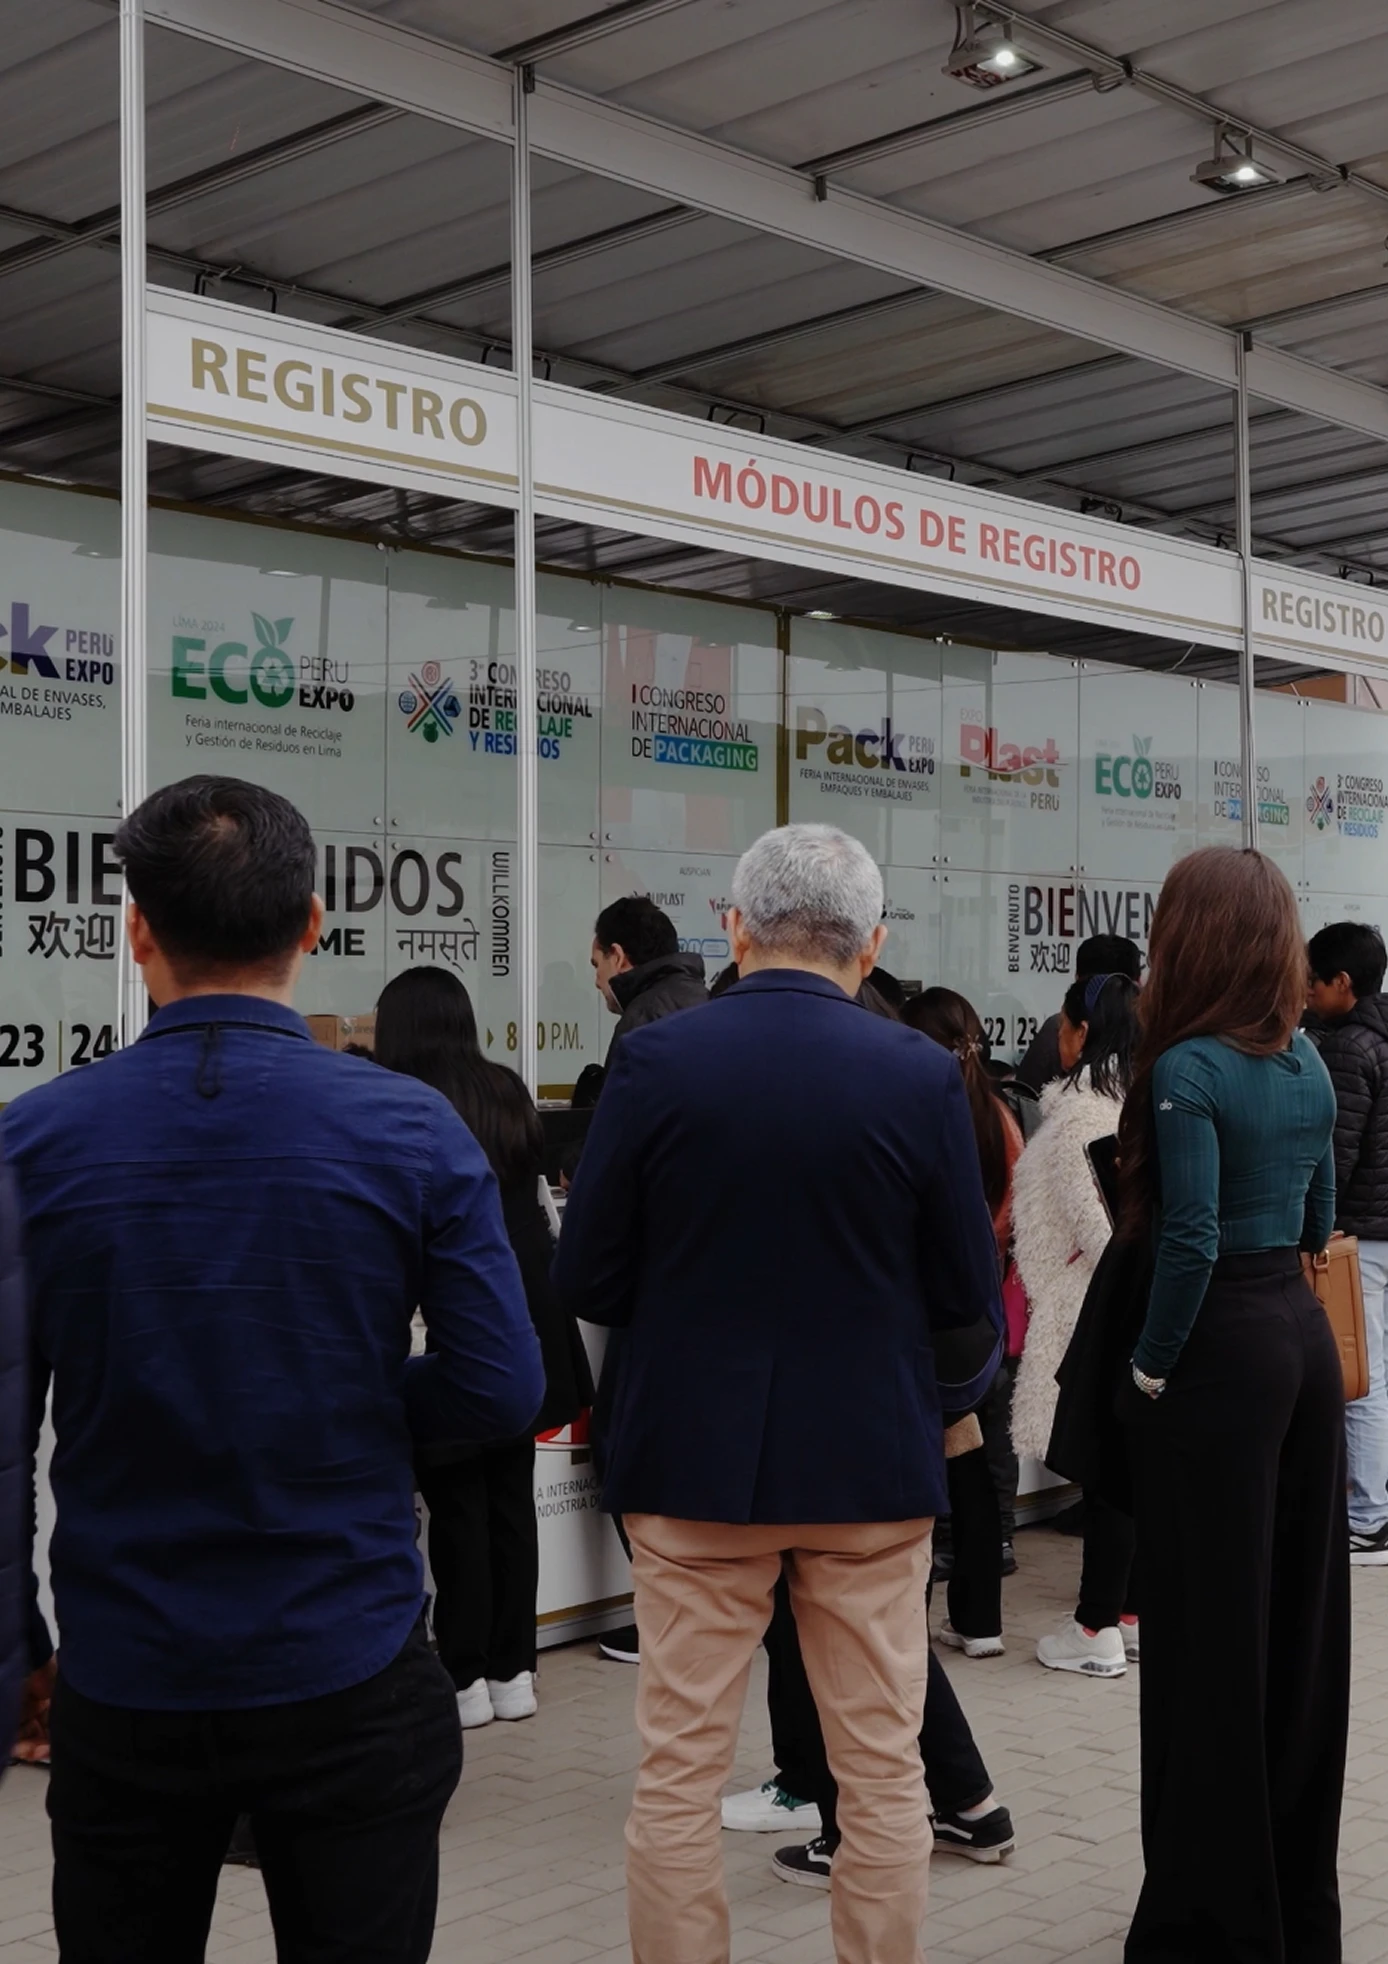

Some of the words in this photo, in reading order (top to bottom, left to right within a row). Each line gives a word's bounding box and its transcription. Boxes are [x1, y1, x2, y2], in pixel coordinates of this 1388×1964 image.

[191, 337, 487, 447] REGISTRO
[693, 455, 905, 541] MÓDULOS
[919, 509, 966, 554] DE
[980, 524, 1141, 591] REGISTRO
[200, 621, 226, 632] 2024
[1262, 587, 1384, 643] REGISTRO
[66, 658, 114, 685] EXPO
[172, 635, 296, 708] ECO
[488, 661, 571, 692] CONRESO
[0, 702, 72, 721] MBALAJES
[21, 687, 39, 701] DE
[44, 689, 107, 709] ENVASES,
[299, 683, 355, 712] EXPO
[469, 683, 593, 718] INTERCIONAL
[632, 683, 637, 704] I
[640, 685, 726, 713] CONGRESO
[185, 714, 211, 729] Feria
[214, 716, 282, 735] internacional
[284, 724, 297, 738] de
[300, 725, 342, 741] Reciclaje
[469, 707, 490, 730] DE
[495, 710, 573, 738] RELAJE
[632, 710, 753, 743] INTERNACIONAL
[960, 708, 983, 722] EXPO
[185, 735, 192, 746] y
[195, 733, 236, 748] Gestión
[239, 737, 252, 750] de
[256, 739, 300, 754] Residuos
[303, 745, 315, 755] en
[318, 745, 342, 758] Lima
[469, 731, 479, 751] Y
[485, 732, 560, 760] RESIOS
[796, 705, 907, 771] Pack
[632, 736, 652, 759] DE
[655, 738, 758, 770] PACKAGING
[909, 757, 935, 775] EXPO
[960, 723, 1060, 788] Plast
[800, 768, 822, 779] FERIA
[824, 771, 884, 786] INTERNACIONAL
[886, 778, 896, 788] DE
[897, 779, 931, 793] ENVASES,
[1095, 752, 1152, 799] ECO
[1155, 762, 1179, 781] PERU
[1219, 761, 1270, 782] CONSO
[1345, 775, 1383, 793] CONGRESO
[820, 782, 862, 797] EMPAQUES
[864, 788, 870, 797] Y
[871, 787, 913, 800] EMBALAJES
[1155, 781, 1181, 800] EXPO
[1337, 790, 1388, 809] INTERNACIONA
[1214, 801, 1227, 817] DE
[1228, 803, 1289, 825] PAGING
[1337, 805, 1346, 820] DE
[1348, 806, 1384, 823] RECICLAJE
[1337, 821, 1342, 836] Y
[1344, 822, 1379, 839] RESIDUOS
[15, 828, 464, 917] BIEIDOS
[27, 911, 116, 960] 欢迎
[1008, 884, 1020, 973] BENVENUTO
[1030, 940, 1070, 974] 欢迎
[0, 1023, 45, 1068] 23
[70, 1023, 119, 1067] 24
[551, 1022, 584, 1051] P.M.
[984, 1016, 1006, 1047] 22
[1017, 1017, 1038, 1047] 23
[547, 1477, 599, 1497] INTERNAC
[537, 1496, 588, 1518] NDUSTRIA
